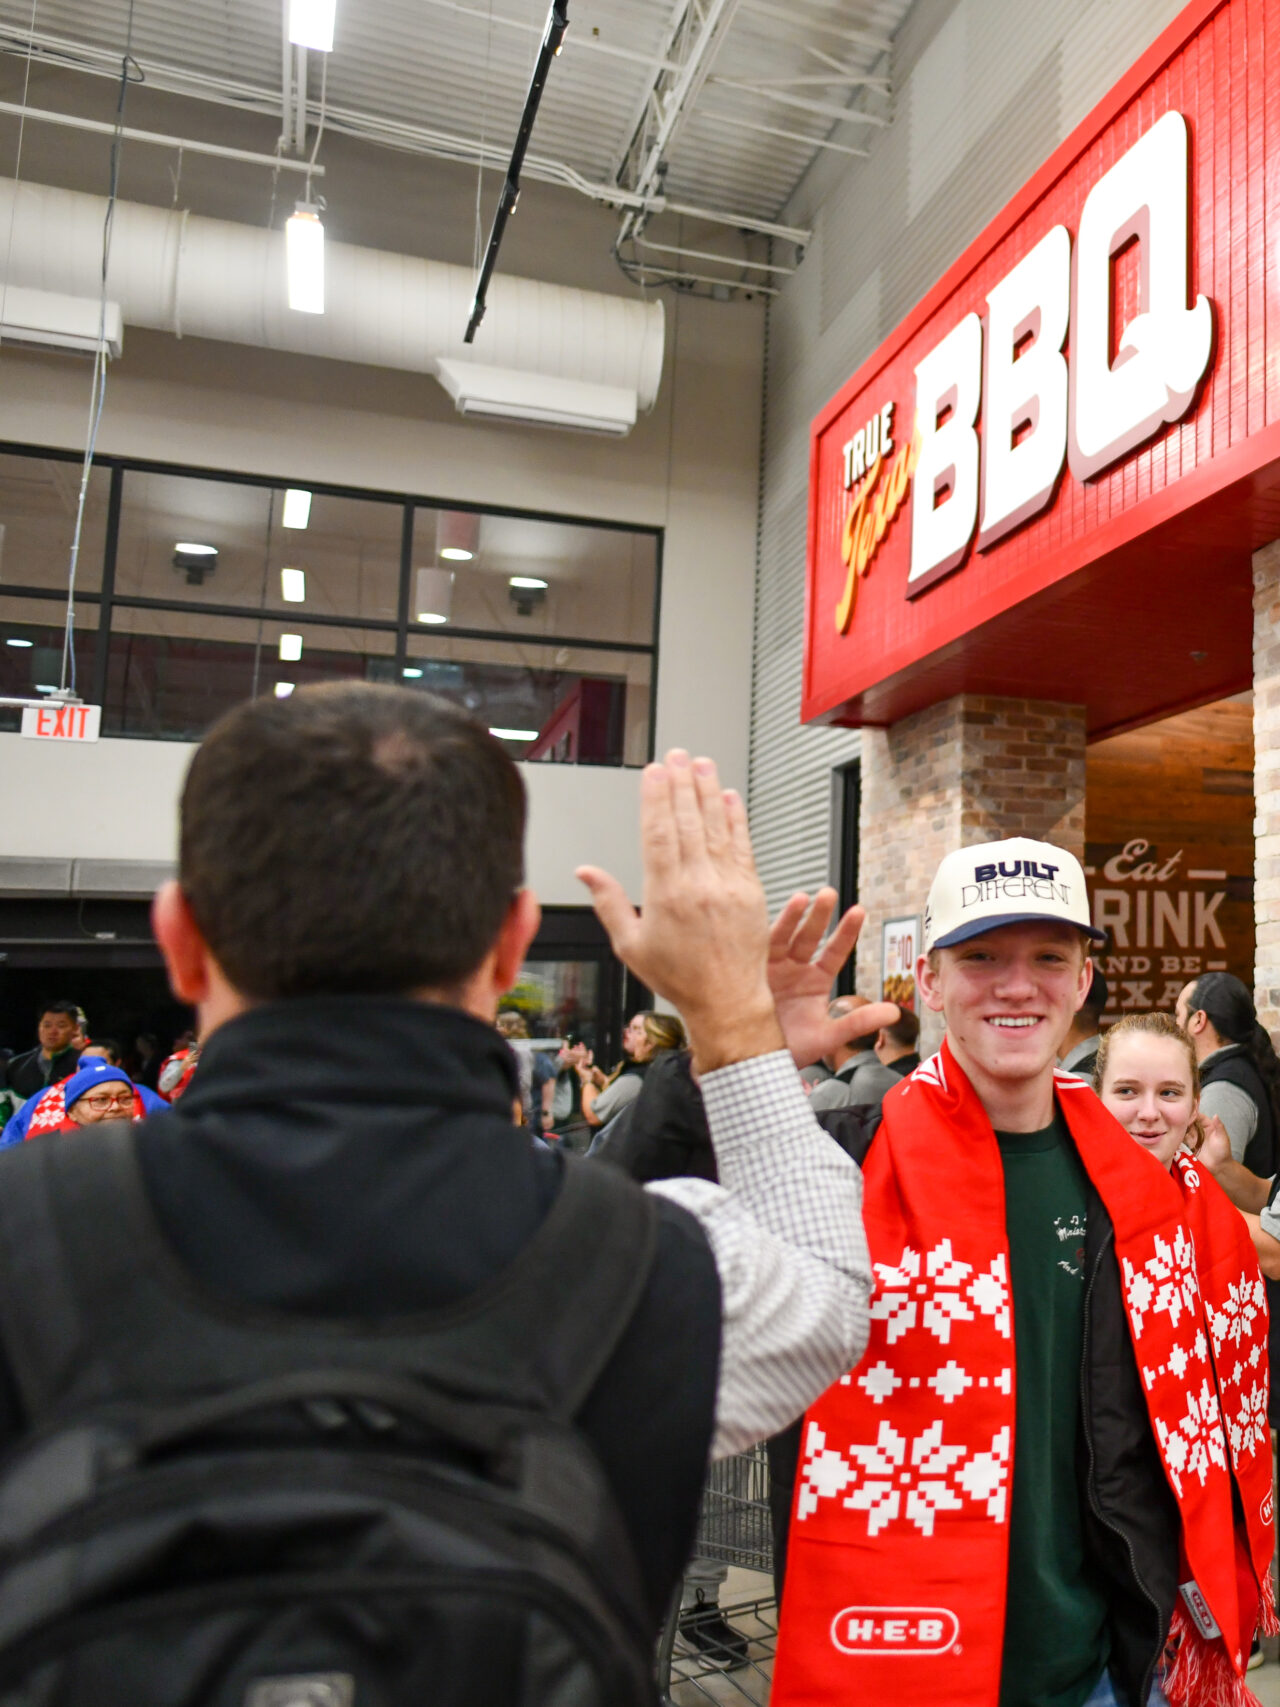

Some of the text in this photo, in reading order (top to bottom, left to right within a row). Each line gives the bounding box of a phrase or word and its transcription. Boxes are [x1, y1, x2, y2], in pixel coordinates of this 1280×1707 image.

[907, 110, 1216, 600] BBQ
[842, 401, 894, 490] TRUE
[36, 707, 90, 738] EXIT
[974, 860, 1059, 883] BUILT
[1104, 838, 1183, 882] Eat
[961, 876, 1071, 908] DIFFERENT
[1094, 889, 1226, 949] RINK
[1160, 956, 1201, 974] BE
